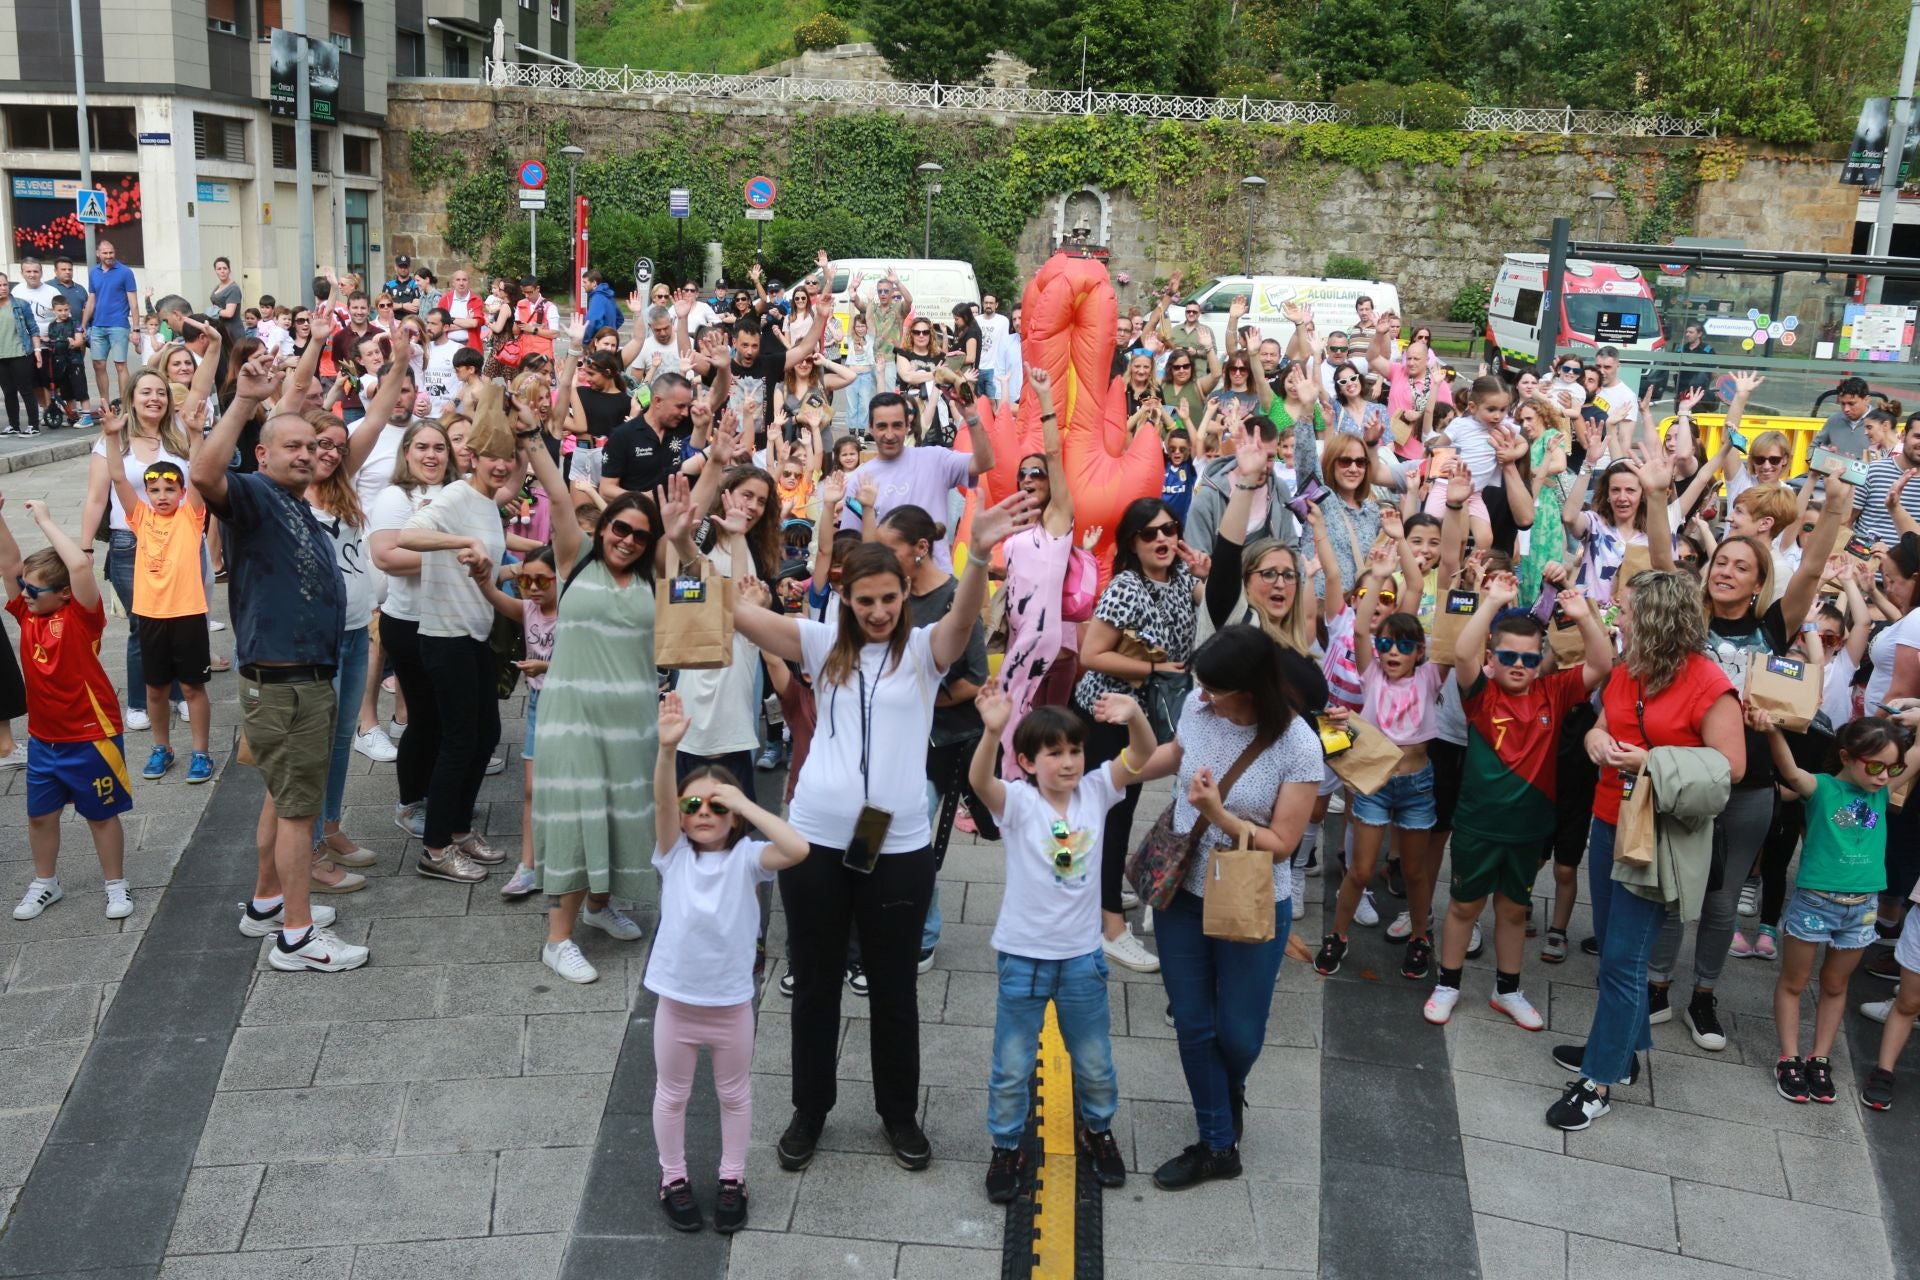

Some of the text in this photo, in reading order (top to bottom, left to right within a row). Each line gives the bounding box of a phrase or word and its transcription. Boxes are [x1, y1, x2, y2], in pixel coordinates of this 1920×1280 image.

[15, 180, 53, 190] SE VENDE
[1708, 323, 1752, 331] Ayuntamiento
[675, 580, 701, 590] HOLI
[684, 589, 701, 599] KIT
[1452, 596, 1474, 605] HOLI
[1775, 659, 1799, 671] HOLI
[1494, 725, 1507, 751] 7
[92, 776, 114, 797] 19
